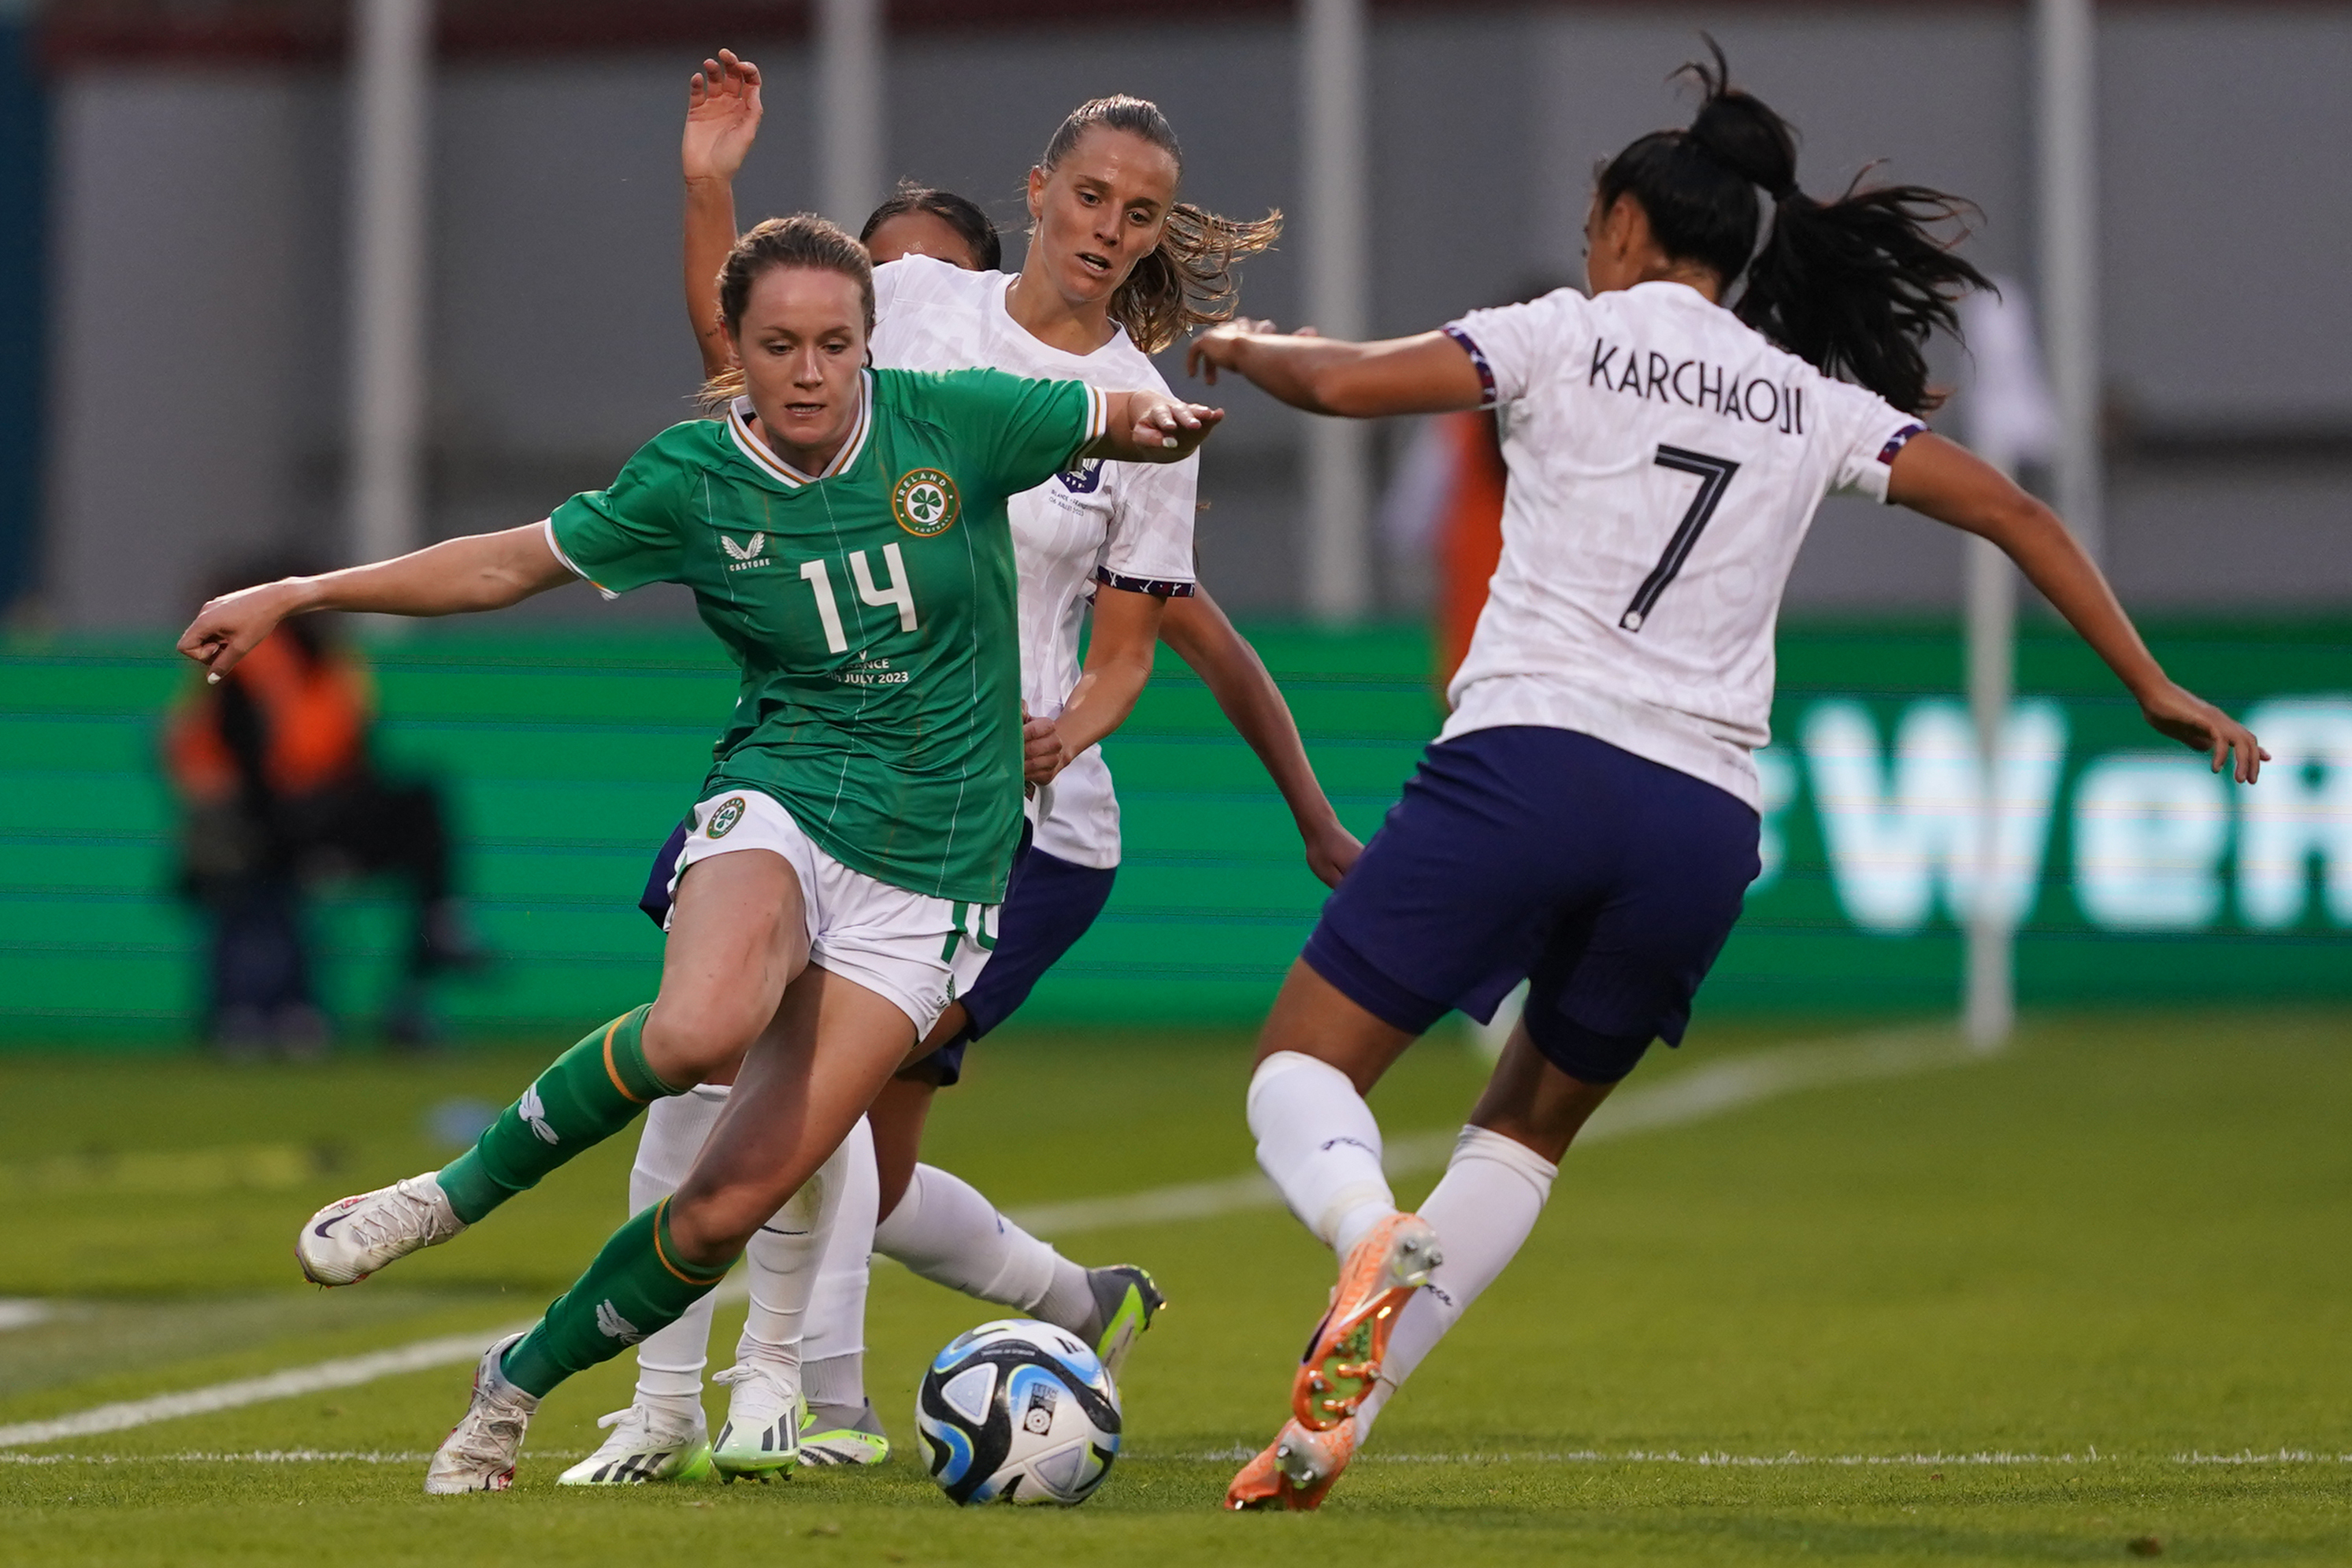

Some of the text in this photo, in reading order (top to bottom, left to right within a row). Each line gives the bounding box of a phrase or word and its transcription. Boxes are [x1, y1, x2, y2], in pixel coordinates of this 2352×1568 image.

[896, 473, 947, 502] IRELAND
[1619, 443, 1742, 632] 7
[729, 558, 771, 573] CASTORE
[799, 542, 918, 654] 14
[844, 673, 874, 684] JULY
[877, 671, 909, 684] 2023
